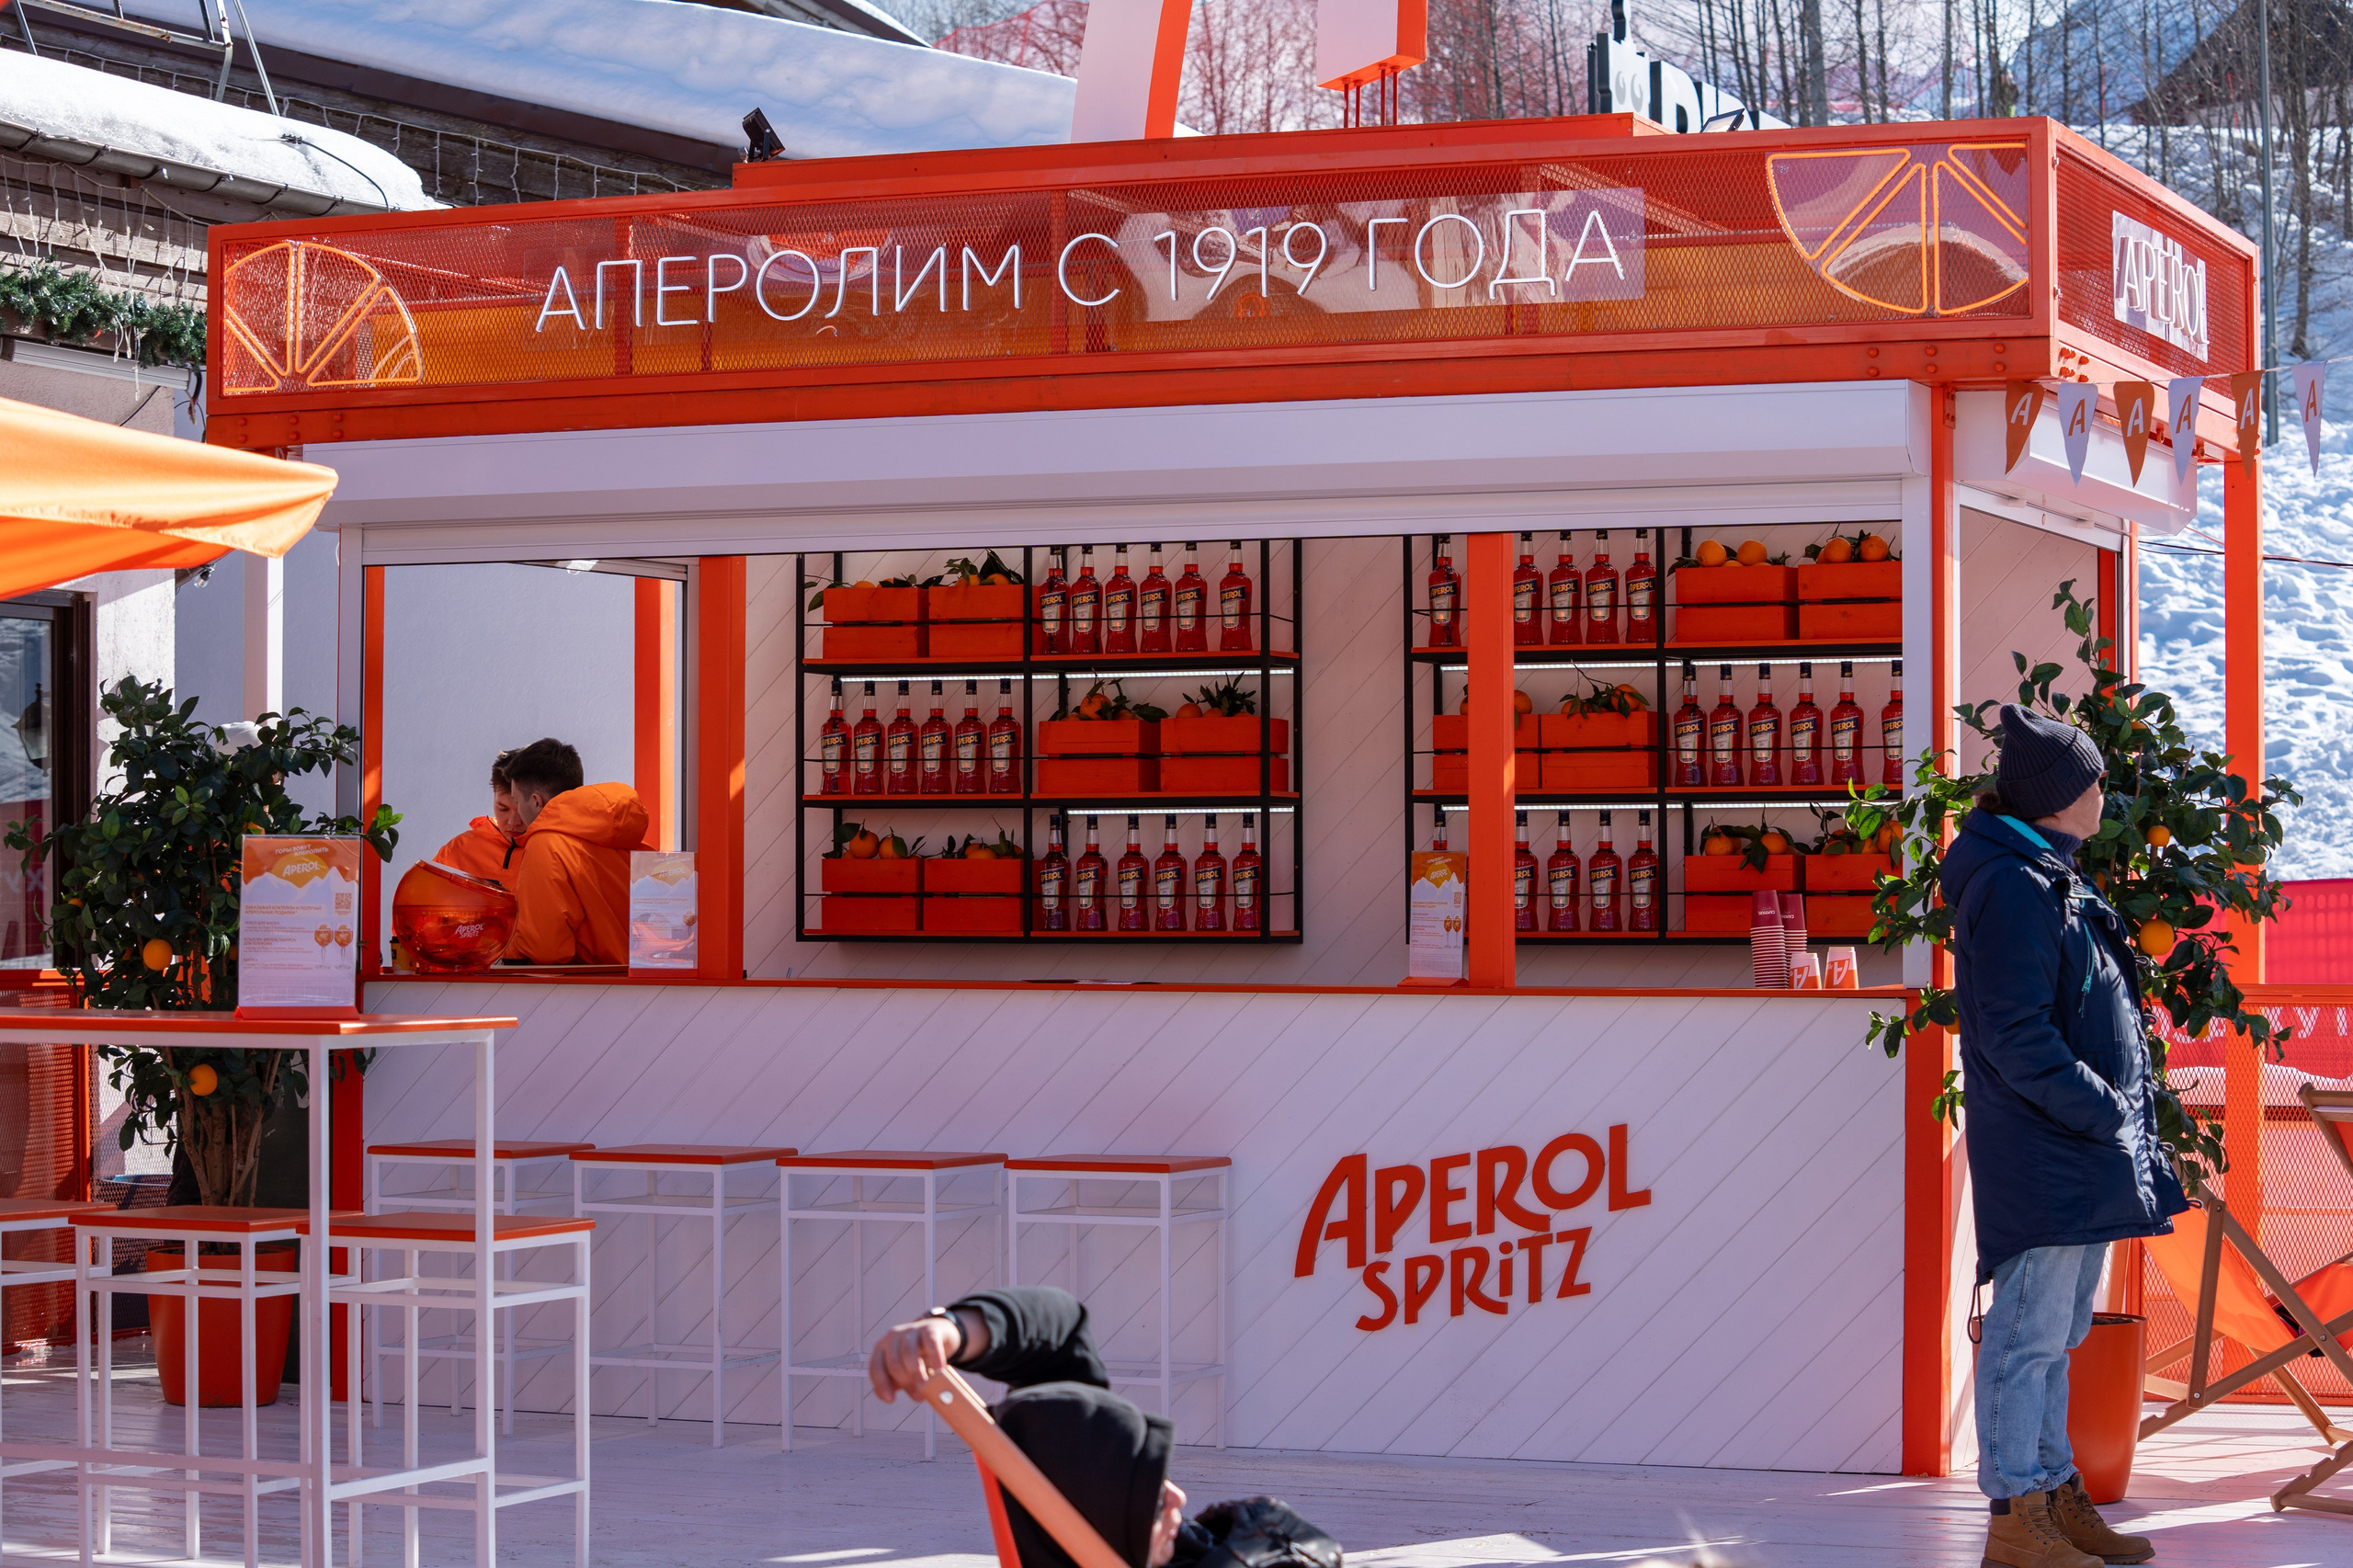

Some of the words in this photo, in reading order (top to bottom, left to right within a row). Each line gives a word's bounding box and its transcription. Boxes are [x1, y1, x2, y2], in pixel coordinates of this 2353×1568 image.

[536, 244, 1021, 332] АПЕРОЛИМ
[1059, 233, 1121, 306] С
[1154, 221, 1328, 301] 1919
[1369, 210, 1625, 301] ГОДА
[2120, 235, 2210, 346] APEROL
[2305, 379, 2318, 423] A
[2010, 392, 2033, 426] A
[2176, 393, 2192, 435] A
[2239, 387, 2255, 430] A
[2068, 398, 2086, 437] A
[2127, 397, 2144, 437] A
[1430, 585, 1454, 597] APEROL
[1552, 582, 1574, 595] APEROL
[1588, 582, 1612, 595] APEROL
[1629, 581, 1653, 593] APEROL
[1040, 595, 1063, 607] APEROL
[1073, 594, 1096, 606] APEROL
[1107, 593, 1129, 605] APEROL
[1142, 592, 1163, 603] APEROL
[1176, 591, 1198, 602] APEROL
[1221, 590, 1242, 601] APEROL
[1676, 723, 1700, 736] APEROL
[1711, 723, 1735, 735] APEROL
[1750, 722, 1775, 734] APEROL
[1791, 722, 1813, 733] APEROL
[1833, 722, 1856, 733] APEROL
[1883, 721, 1903, 733] APERO
[823, 737, 844, 747] APEROL
[856, 736, 877, 747] APEROL
[889, 735, 910, 745] APEROL
[922, 735, 943, 745] APEROL
[957, 734, 979, 745] APEROL
[991, 734, 1012, 745] APEROL
[276, 846, 291, 855] ГОРЫ
[292, 844, 312, 852] ЗОВУТ
[293, 846, 329, 857] АПЕРОЛИТЬ
[282, 860, 320, 877] APEROL
[1040, 871, 1062, 882] APEROL
[1119, 870, 1140, 882] APEROL
[1155, 871, 1177, 882] APEROL
[1197, 870, 1219, 881] APEROL
[1233, 870, 1256, 881] APEROL
[1429, 869, 1449, 881] APEROL
[1549, 869, 1573, 881] APEROL
[1590, 869, 1613, 881] APEROL
[1631, 869, 1654, 881] APEROL
[454, 923, 483, 935] APEROL
[1294, 1123, 1652, 1278] APEROL
